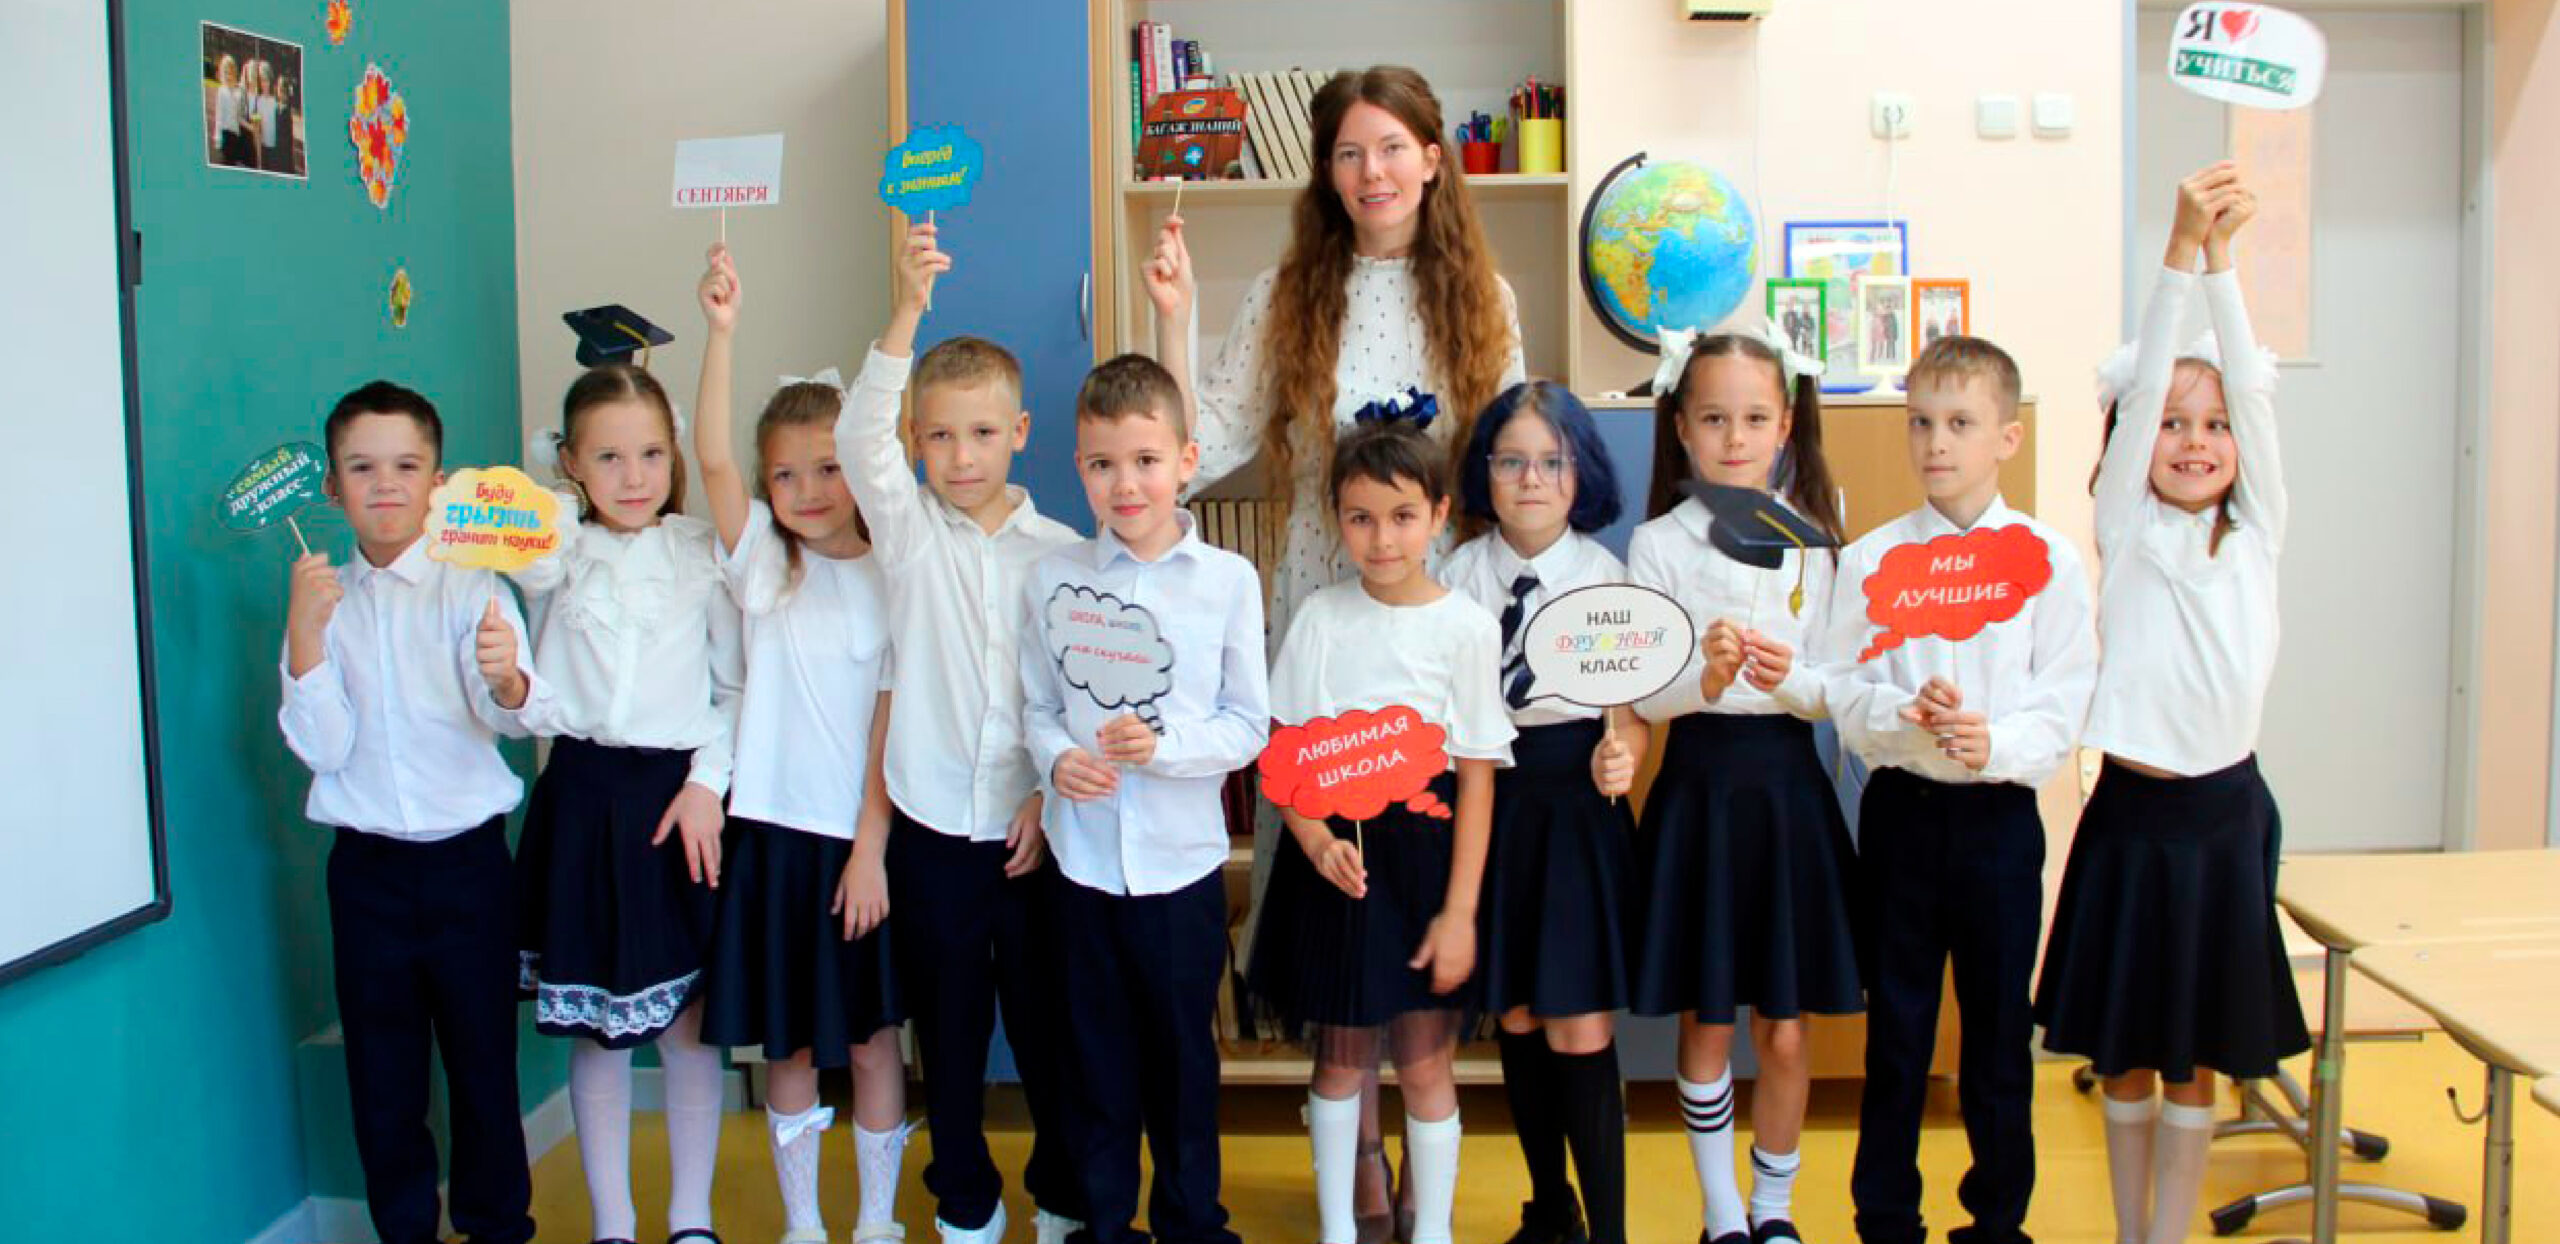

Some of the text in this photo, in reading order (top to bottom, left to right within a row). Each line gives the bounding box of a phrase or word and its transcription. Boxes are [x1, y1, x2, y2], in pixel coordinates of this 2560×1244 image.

[2183, 9, 2215, 41] Я
[2176, 52, 2296, 91] УЧИТЬСЯ
[676, 185, 768, 203] СЕНТЯБРЯ
[476, 482, 515, 505] Буду
[503, 534, 554, 552] науки!
[1930, 553, 1978, 575] МЫ
[1892, 581, 2011, 609] ЛУЧШИЕ
[1586, 610, 1631, 626] НАШ
[1555, 626, 1668, 652] ДРУНЫЙ
[1580, 656, 1641, 674] КЛАСС
[1296, 715, 1410, 765] ЛЮБИМАЯ
[1317, 748, 1408, 787] ШКОЛА
